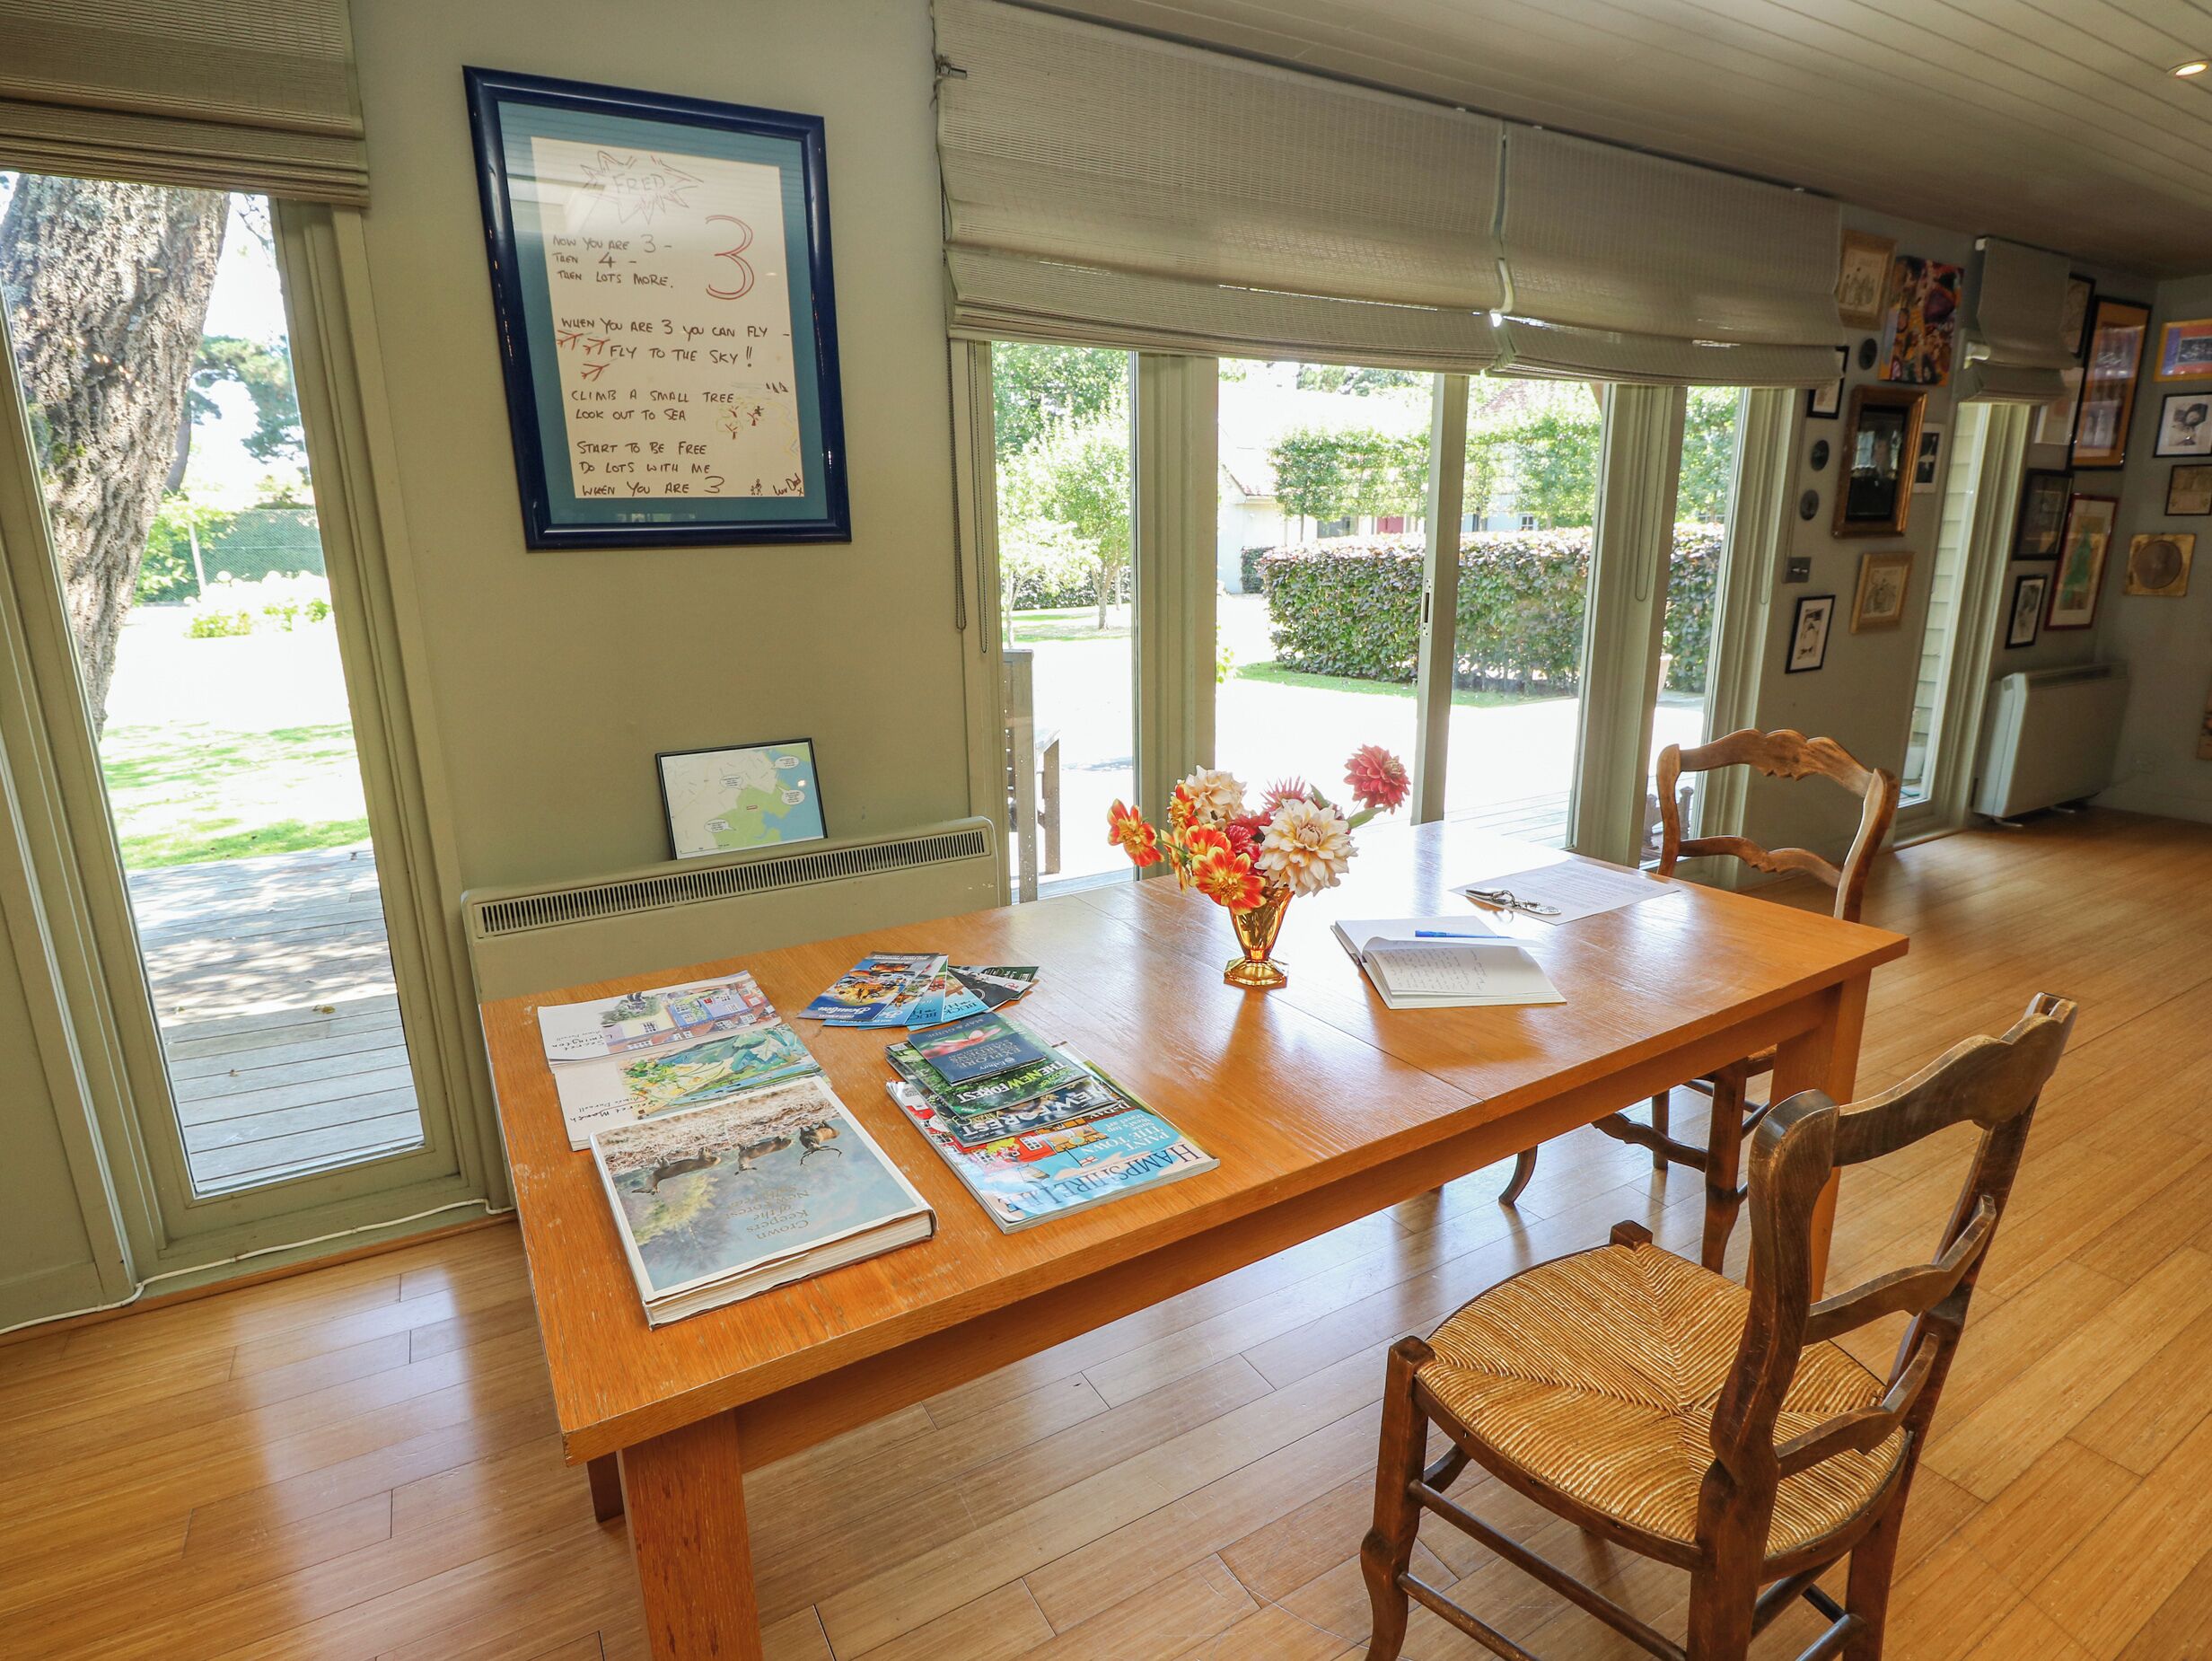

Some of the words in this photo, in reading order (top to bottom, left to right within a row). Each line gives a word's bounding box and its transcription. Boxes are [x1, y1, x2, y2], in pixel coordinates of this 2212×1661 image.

[612, 172, 666, 194] FRED
[553, 234, 576, 248] NOW
[583, 236, 603, 250] YOU
[608, 240, 629, 250] ARE
[640, 233, 657, 253] 3
[553, 252, 579, 264] THEN
[598, 251, 616, 268] 4
[705, 215, 754, 300] 3
[557, 270, 582, 281] THEN
[596, 271, 621, 284] LOTS
[562, 318, 594, 328] WHEN
[600, 318, 622, 334] YOU
[631, 321, 653, 332] ARE
[661, 319, 673, 334] 3
[682, 326, 704, 341] YOU
[712, 327, 735, 338] CAN
[747, 325, 768, 338] FLY
[610, 345, 637, 359] FLY
[649, 347, 665, 359] TO
[671, 348, 698, 361] THE
[571, 390, 617, 401] CLIMB
[629, 389, 638, 400] A
[650, 391, 689, 403] SMALL
[702, 391, 734, 403] TREE
[575, 409, 605, 419] LOOK
[612, 410, 635, 420] OUT
[664, 409, 686, 421] SEA
[576, 441, 619, 454] START
[625, 442, 641, 453] TO
[649, 442, 665, 453] BE
[678, 441, 707, 455] FREE
[606, 462, 635, 473] LOTS
[646, 462, 679, 473] WITH
[691, 463, 711, 474] ME
[582, 485, 616, 497] WHEN
[627, 481, 651, 497] YOU
[664, 483, 689, 495] ARE
[704, 475, 725, 495] 3
[1124, 1131, 1171, 1151] PAINT
[1128, 1125, 1163, 1139] THE
[1080, 1137, 1129, 1155] TOWN
[1054, 1145, 1201, 1198] HAMPSHIRE
[776, 1190, 809, 1205] New
[746, 1209, 809, 1233] Keepers
[756, 1220, 809, 1240] Crown
